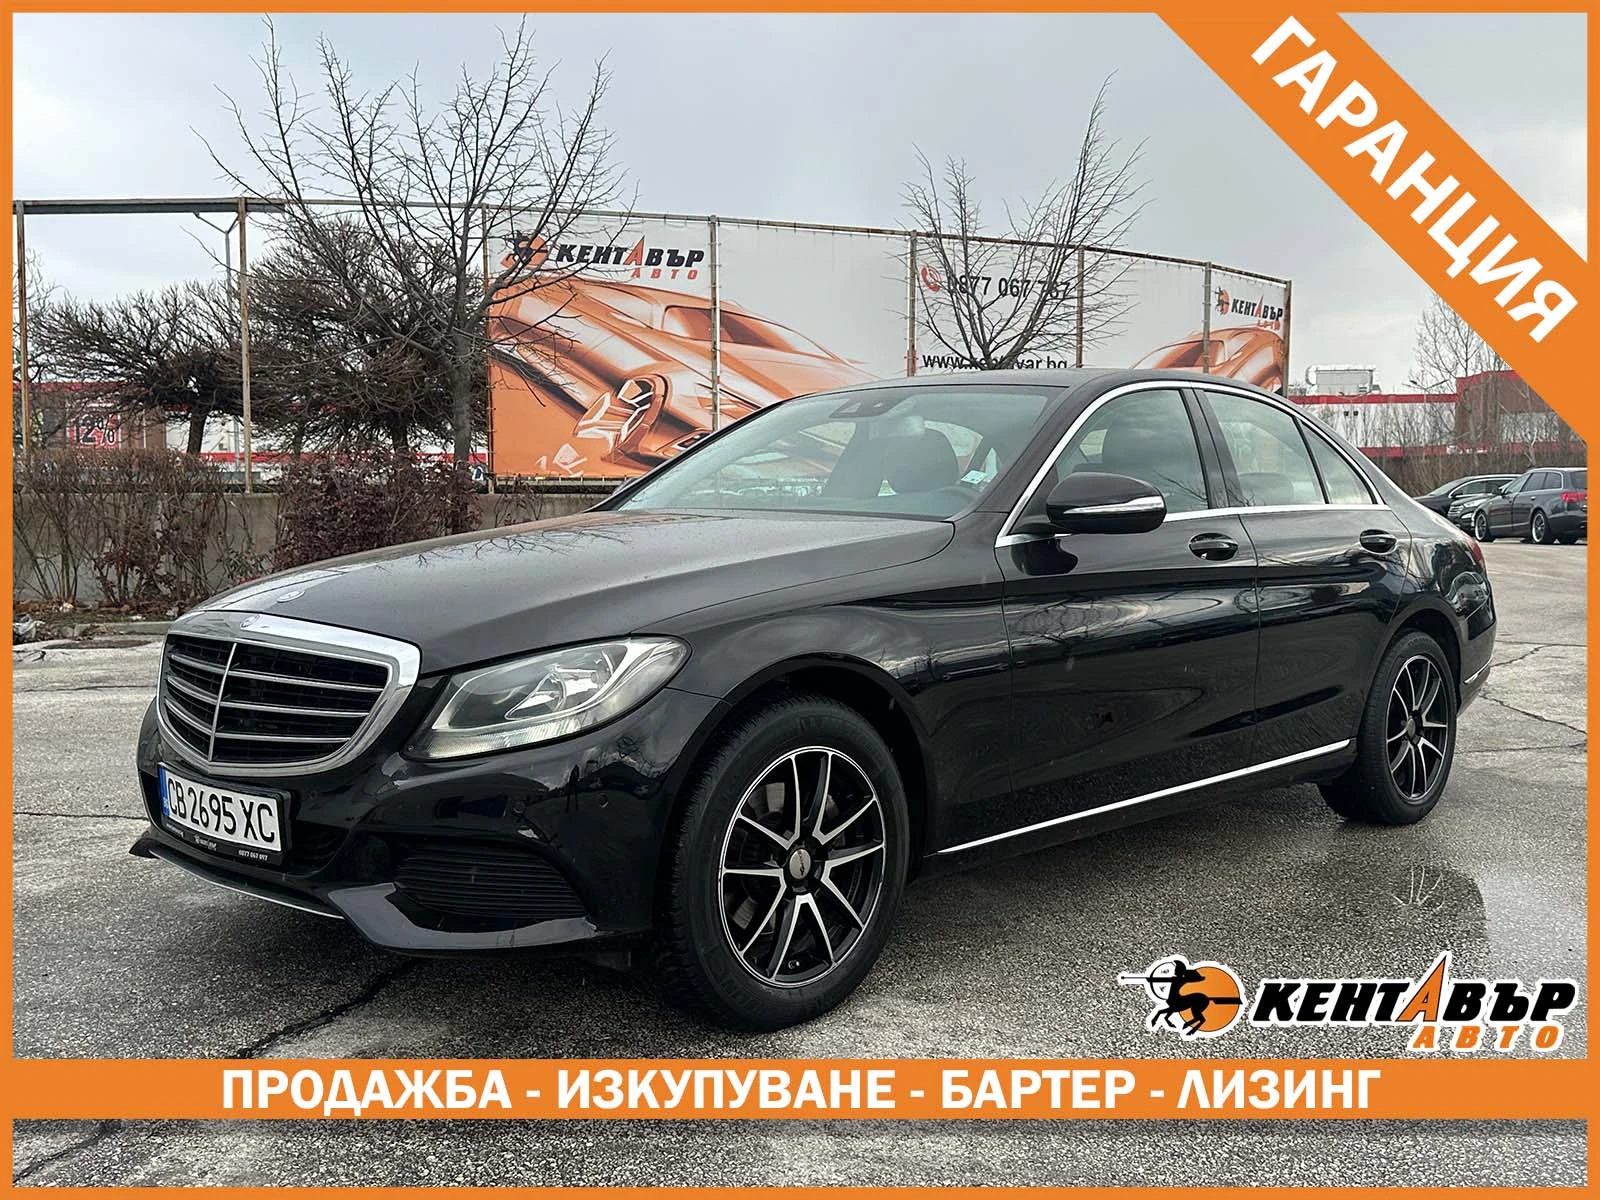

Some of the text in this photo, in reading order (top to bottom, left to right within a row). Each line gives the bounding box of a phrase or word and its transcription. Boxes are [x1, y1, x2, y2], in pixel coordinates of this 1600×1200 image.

[556, 235, 704, 268] КЕНТАВЪР
[631, 267, 698, 280] АВТО
[997, 277, 1030, 298] 067
[1231, 294, 1284, 321] КЕНТАВЪР
[168, 778, 187, 819] CB
[188, 787, 236, 835] 2695
[240, 799, 275, 843] XC
